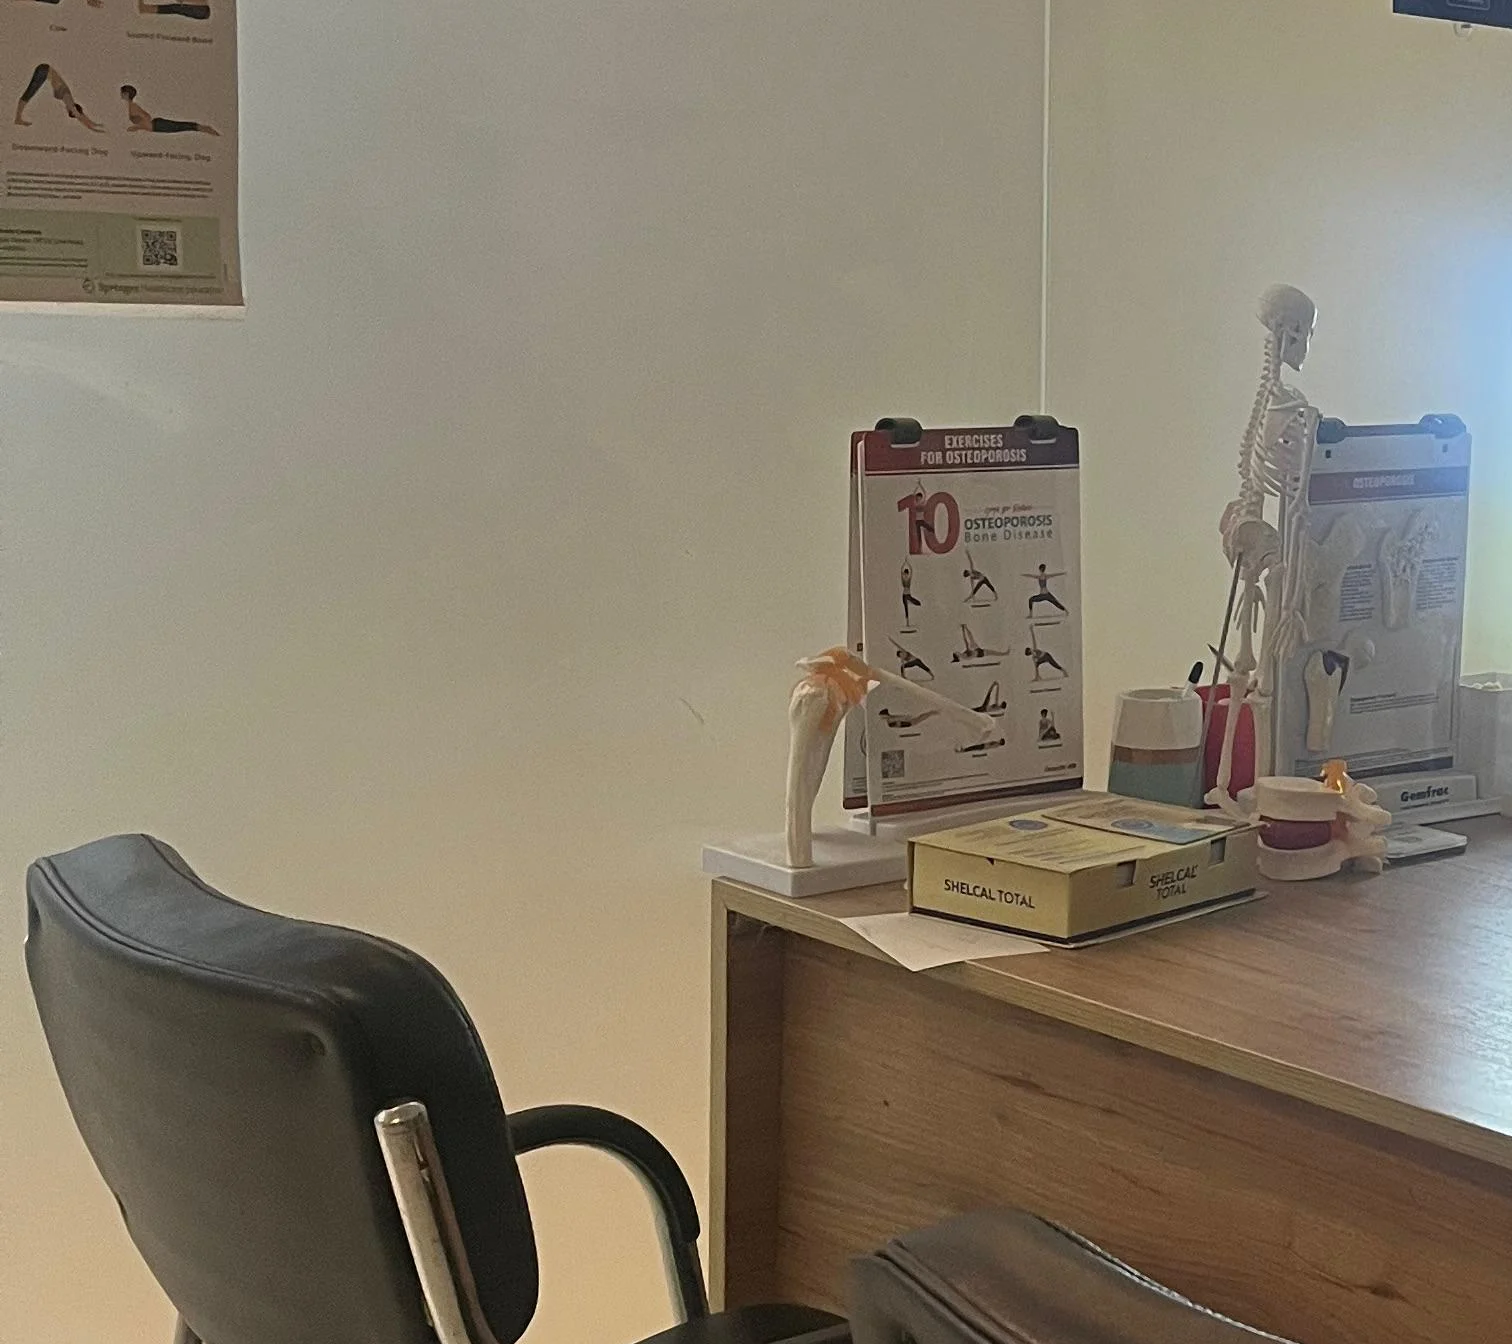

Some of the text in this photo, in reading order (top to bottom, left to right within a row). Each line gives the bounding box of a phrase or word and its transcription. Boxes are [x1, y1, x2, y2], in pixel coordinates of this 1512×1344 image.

[944, 434, 1004, 449] EXERCISES
[921, 449, 1027, 465] FOR OSTEOPOROSIS
[897, 490, 960, 556] 10
[964, 515, 1053, 530] OSTEOPOROSIS
[964, 529, 1053, 543] Bone Disease
[1149, 864, 1198, 889] SHELCAL
[944, 879, 1036, 909] SHELCAL TOTAL
[1156, 885, 1187, 900] TOTAL
